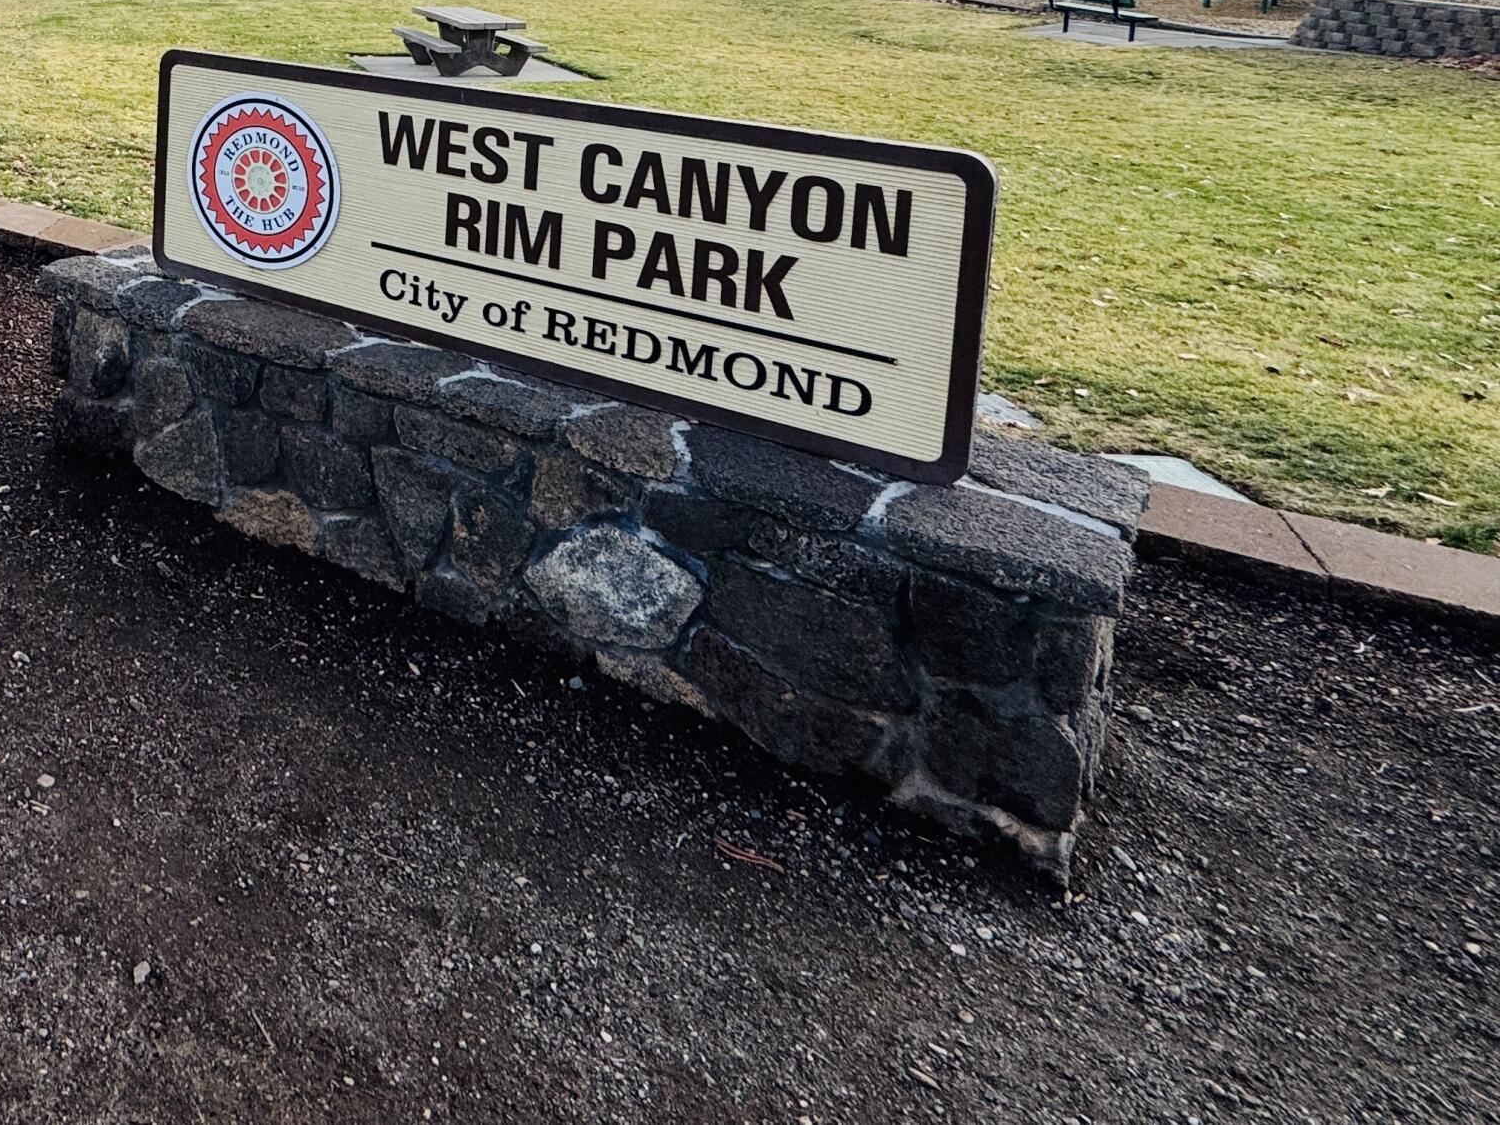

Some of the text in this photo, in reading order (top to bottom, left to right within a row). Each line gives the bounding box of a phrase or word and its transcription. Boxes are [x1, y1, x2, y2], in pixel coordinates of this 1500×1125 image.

[223, 132, 300, 173] REDMOND
[225, 195, 295, 231] THE HUB
[379, 111, 912, 257] WEST CANYON
[445, 192, 799, 320] RIM PARK
[380, 270, 871, 416] City of REDMOND
